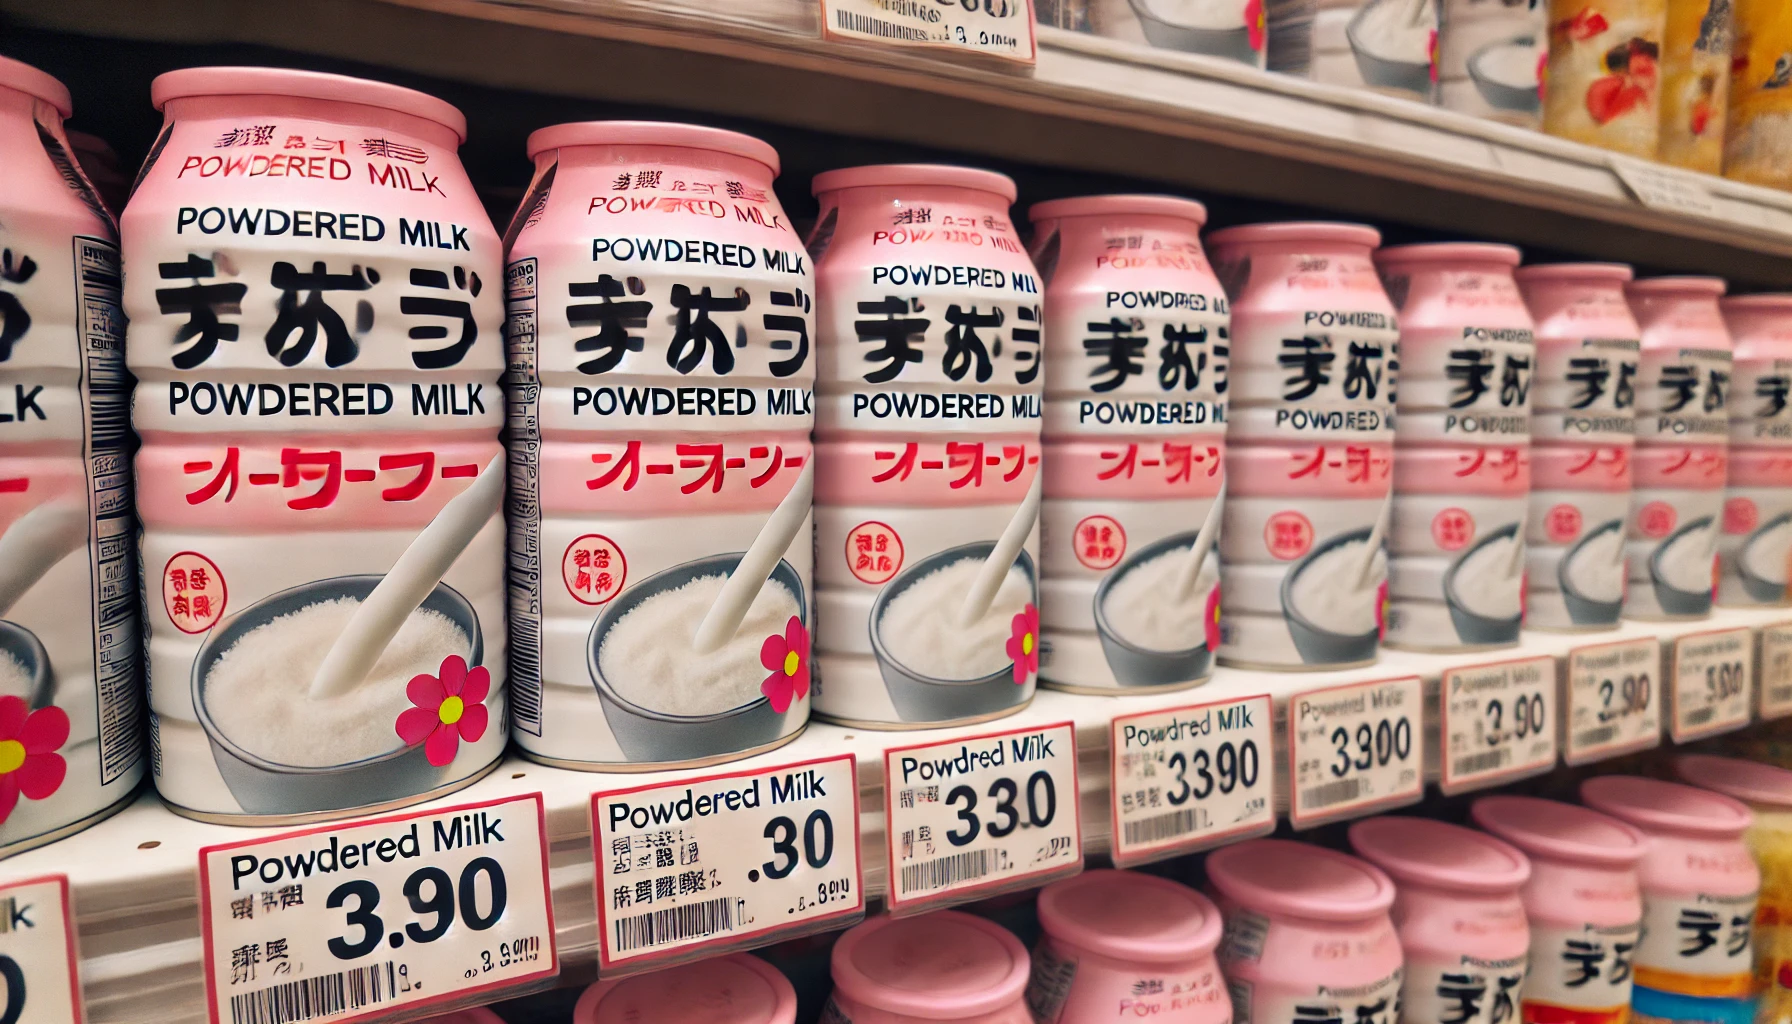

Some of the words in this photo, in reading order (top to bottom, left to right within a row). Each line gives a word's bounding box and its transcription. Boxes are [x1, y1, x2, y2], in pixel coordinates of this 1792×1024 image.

[178, 155, 351, 180] POWDERED
[368, 163, 446, 198] MILK
[177, 207, 385, 242] POWDERED
[399, 218, 471, 251] MILK
[592, 238, 756, 268] POWDERED
[873, 265, 1006, 289] POWDERED
[169, 381, 393, 416] POWDERED
[412, 383, 485, 416] MILK
[573, 387, 756, 416] POWDERED
[767, 389, 812, 415] MILK
[853, 393, 1005, 419] POWDERED
[902, 741, 1005, 784] Powdred
[1167, 739, 1259, 806] 3390
[609, 779, 760, 832] Powdered
[771, 770, 826, 804] Milk
[231, 824, 420, 890] Powdered
[433, 811, 505, 852] Milk
[748, 809, 834, 882] .30
[326, 856, 507, 960] 3.90
